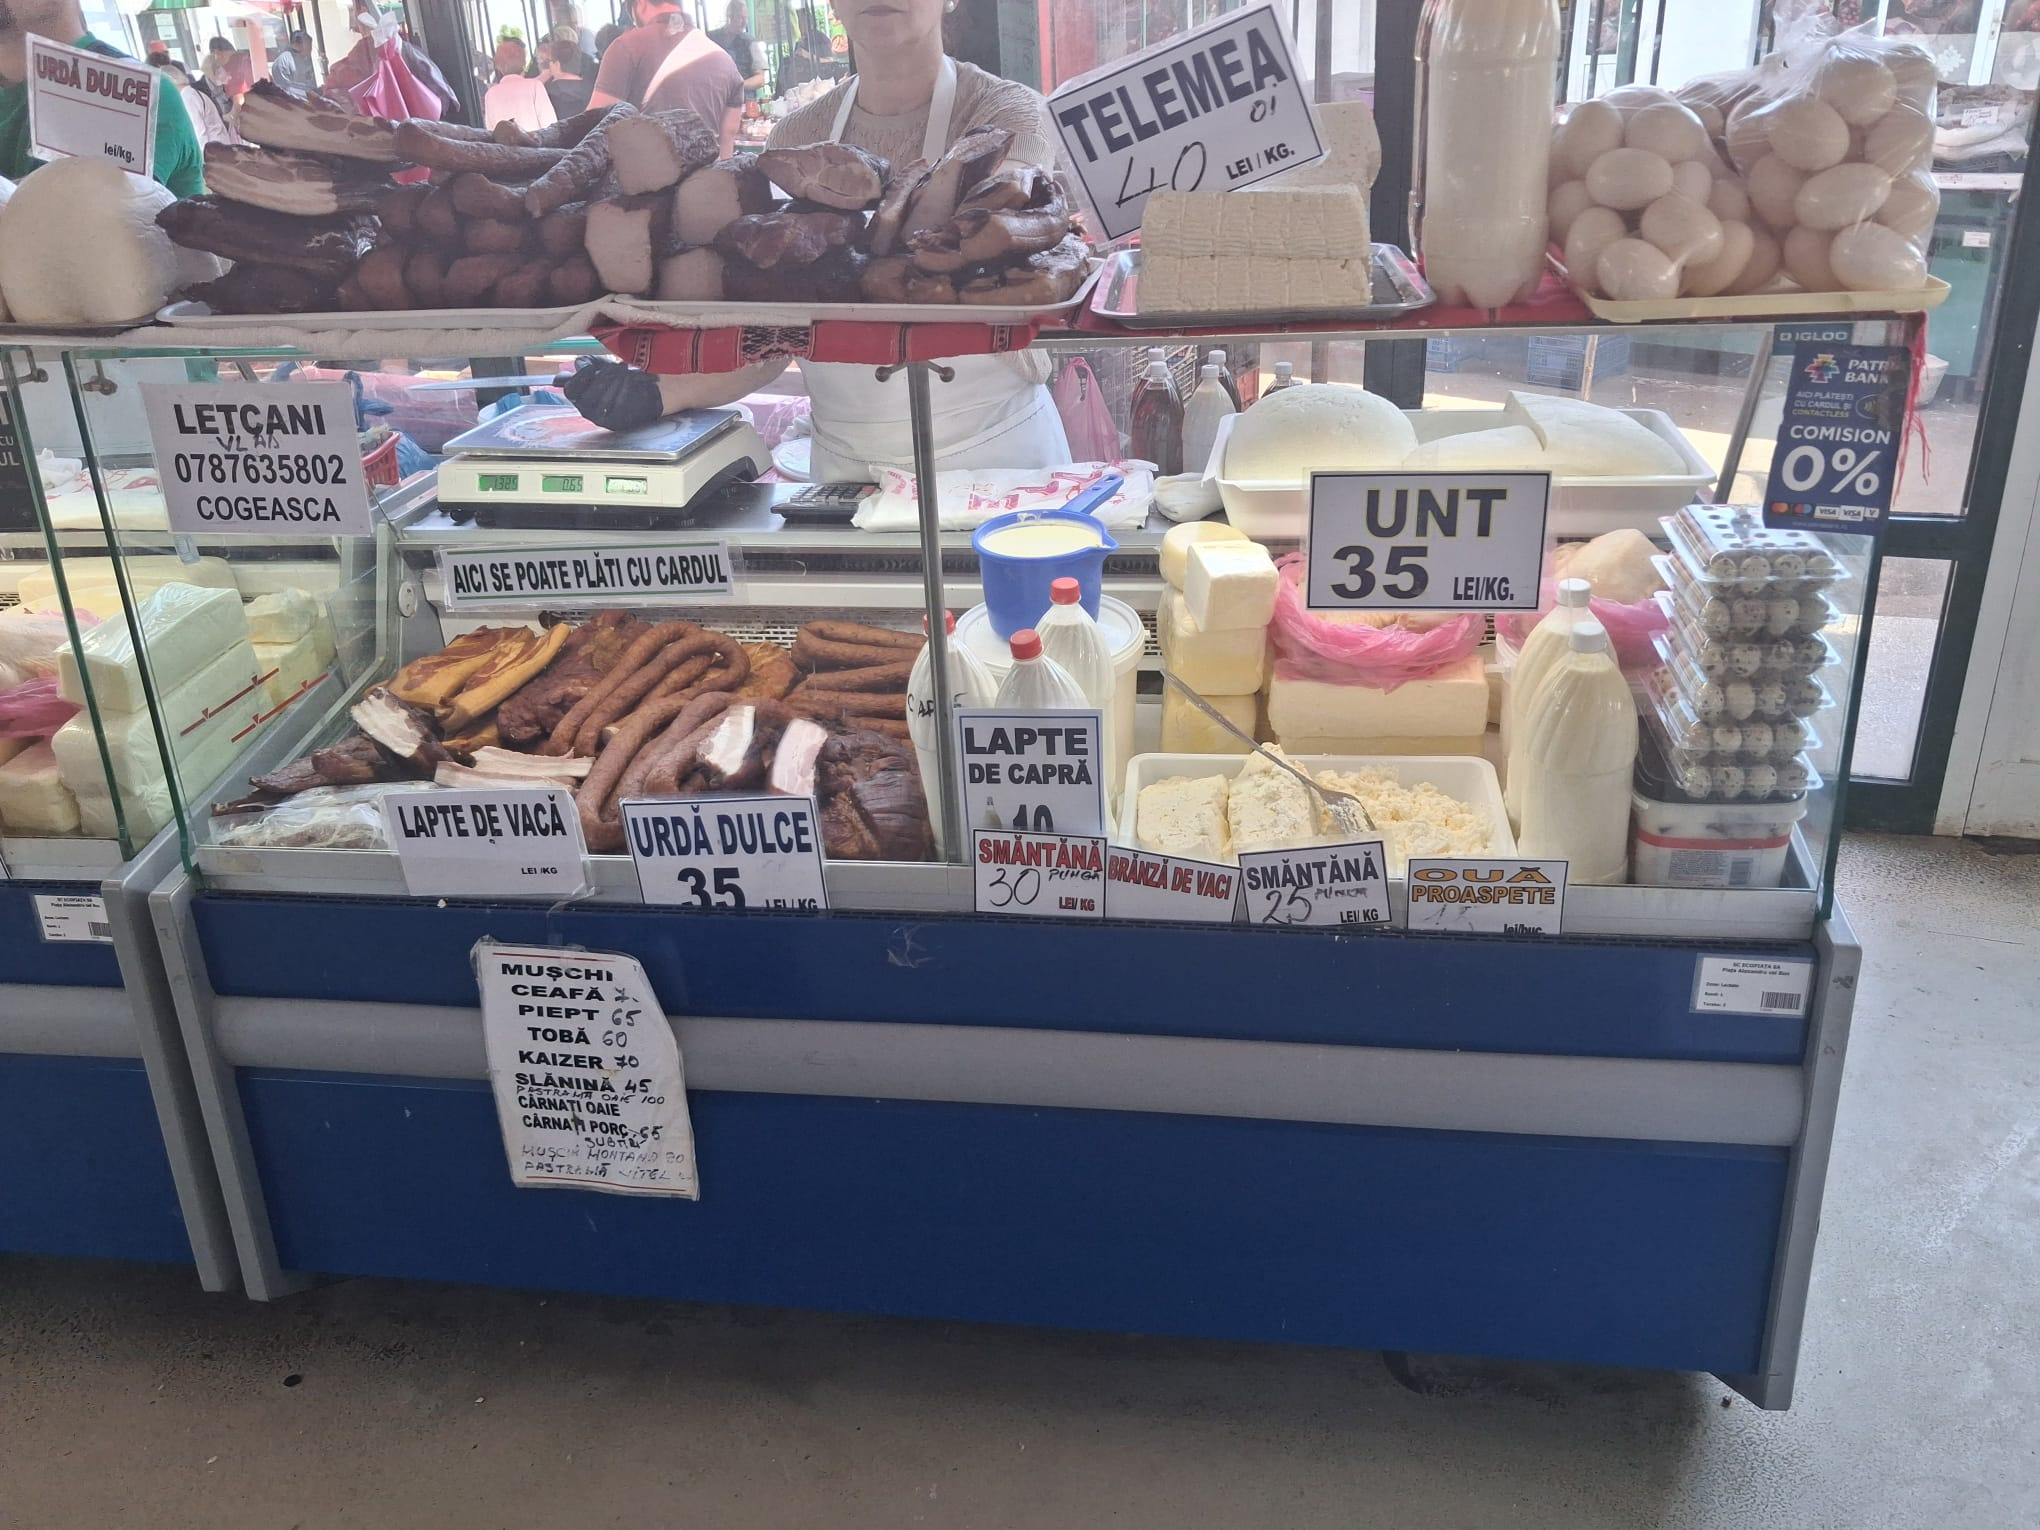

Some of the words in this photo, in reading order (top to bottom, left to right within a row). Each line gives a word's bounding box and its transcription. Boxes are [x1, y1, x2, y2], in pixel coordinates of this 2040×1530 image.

[35, 53, 82, 90] URDĂ
[86, 67, 150, 107] DULCE
[1058, 27, 1288, 163] TELEMEA
[104, 142, 135, 163] lei/kg.
[1226, 153, 1254, 180] LEI
[1264, 142, 1295, 166] KG.
[1115, 141, 1207, 208] 40
[1795, 331, 1848, 341] IGLOO
[1790, 425, 1891, 444] COMISION
[174, 453, 347, 484] 0787635802
[1782, 445, 1881, 496] 0%
[196, 496, 341, 522] COGEASCA
[1366, 488, 1507, 538] UNT
[453, 564, 487, 593] AICI
[490, 562, 514, 591] SE
[515, 560, 571, 590] POATE
[573, 552, 624, 588] PLĂTI
[627, 557, 652, 586] CU
[655, 553, 728, 585] CARDUL
[1331, 545, 1429, 599] 35
[1453, 576, 1514, 601] LEI/KG.
[964, 728, 1089, 755] LAPTE
[969, 763, 1002, 784] DE
[1008, 759, 1092, 785] CAPRĂ
[397, 804, 470, 838] LAPTE
[503, 794, 567, 837] VACĂ
[631, 804, 714, 858] URDĂ
[716, 811, 813, 855] DULCE
[521, 867, 537, 875] LEI
[1413, 866, 1553, 883] OUĂ
[677, 866, 746, 909] 35
[989, 868, 1041, 907] 30
[1171, 869, 1193, 895] DE
[1197, 871, 1232, 901] VACI
[1411, 885, 1556, 905] PROASPETE
[1080, 898, 1096, 911] KG
[1262, 884, 1313, 925] 25
[1362, 908, 1379, 921] KG
[500, 963, 614, 982] MUȘCHI
[511, 984, 606, 1002] CEAFĂ
[518, 1004, 600, 1021] PIEPT
[611, 1008, 642, 1026] 65
[527, 1026, 591, 1044] TOBĂ
[602, 1030, 628, 1048] 60
[518, 1050, 604, 1070] KAIZER
[515, 1072, 616, 1093] SLĂNINĂ
[625, 1078, 653, 1094] 45
[586, 1100, 621, 1117] OAIE
[641, 1096, 665, 1105] 100
